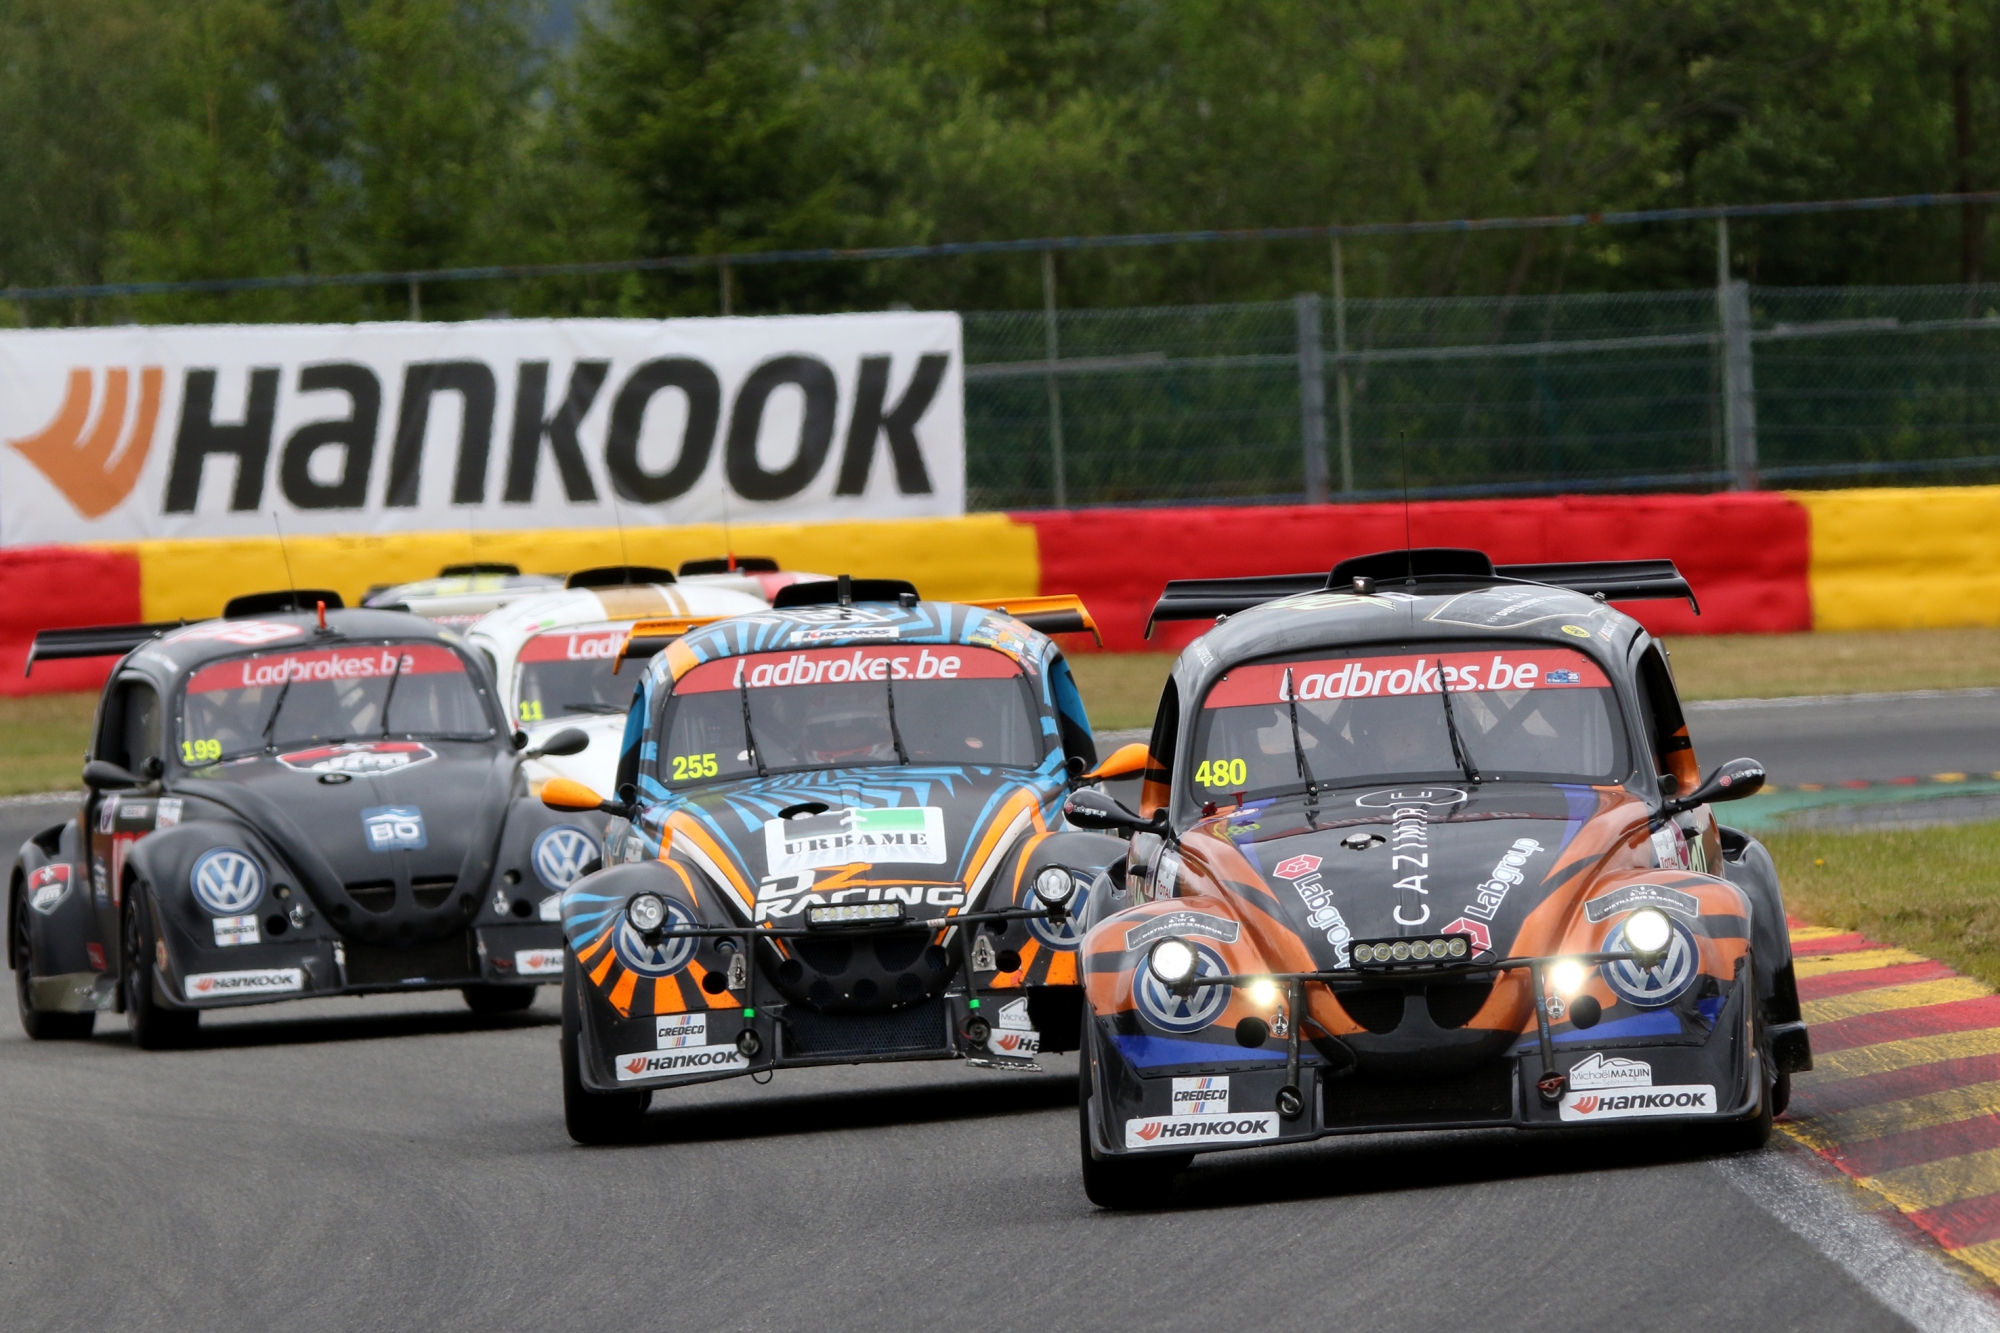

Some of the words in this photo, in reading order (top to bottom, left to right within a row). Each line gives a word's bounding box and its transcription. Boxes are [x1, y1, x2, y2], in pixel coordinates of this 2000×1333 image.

[242, 650, 414, 686] Ladbrokes.be
[733, 648, 961, 689] Ladbrokes.be
[1279, 655, 1539, 701] Ladbrokes.be
[519, 700, 544, 722] 11
[182, 739, 222, 763] 199
[672, 753, 719, 781] 255
[1195, 758, 1247, 787] 480
[370, 822, 420, 842] BO
[784, 832, 928, 855] URBAME
[1464, 837, 1545, 921] Labgroup
[658, 1024, 705, 1038] CREDECO
[1174, 1089, 1228, 1102] CREDECO
